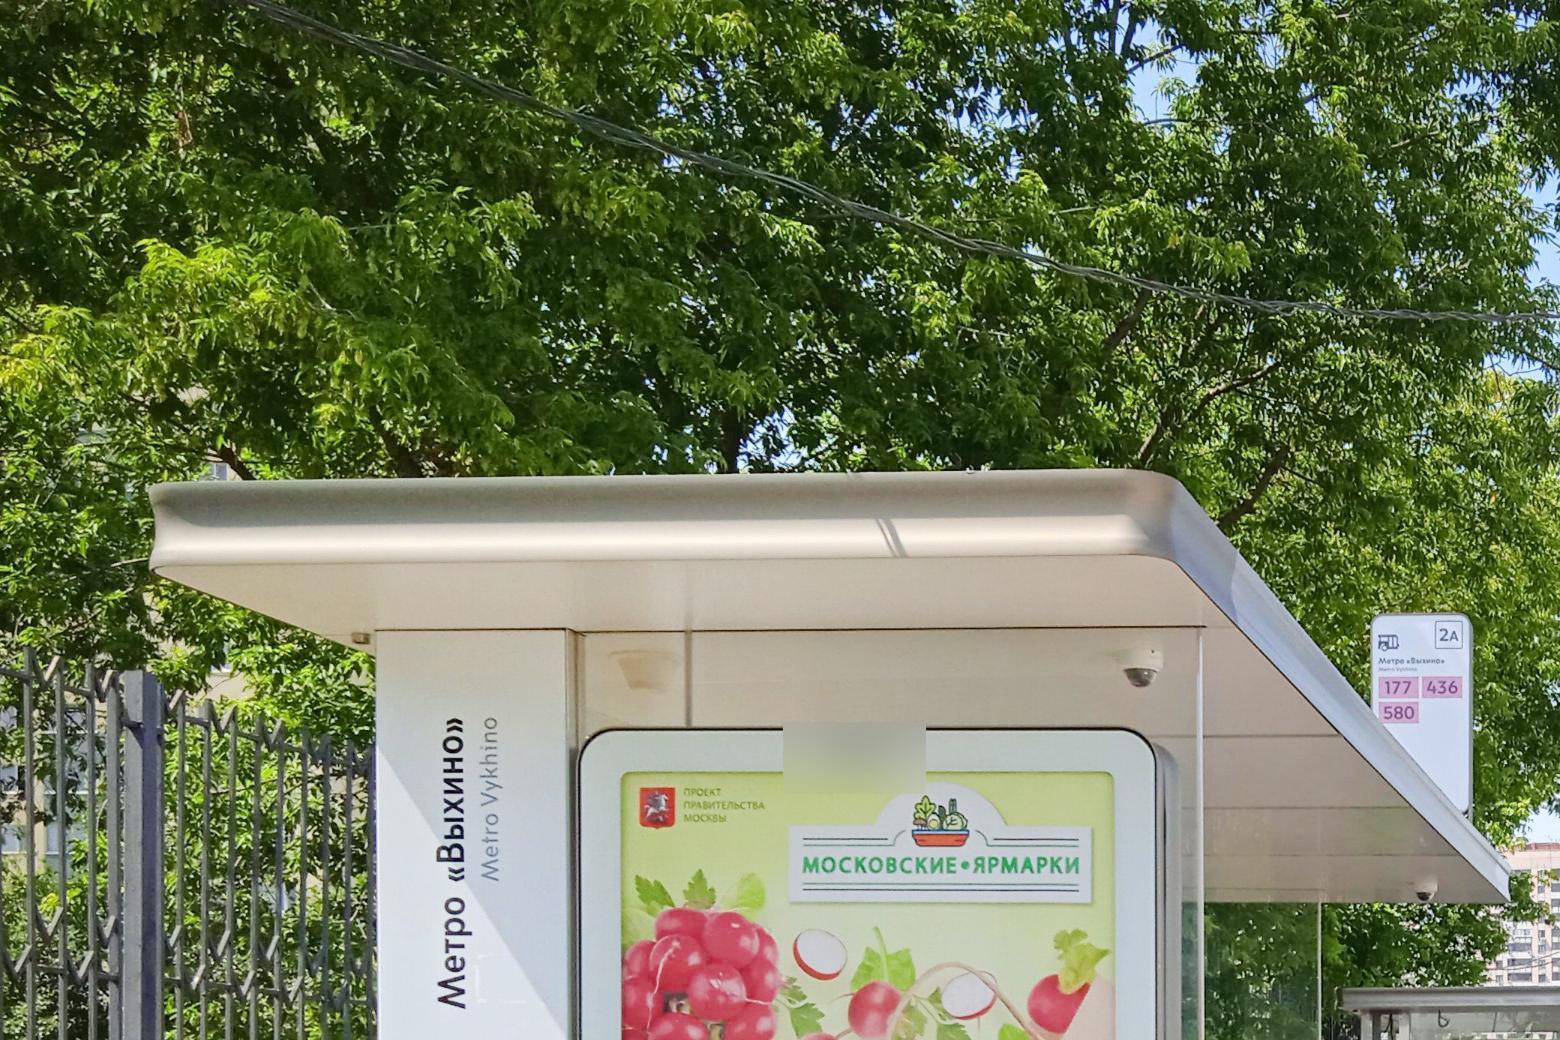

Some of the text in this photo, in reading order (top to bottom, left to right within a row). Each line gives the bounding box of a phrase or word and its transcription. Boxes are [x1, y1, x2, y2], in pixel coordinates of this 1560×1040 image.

[1385, 681, 1458, 695] 177 436
[1383, 706, 1415, 720] 580
[479, 716, 503, 882] Metro Vykhino
[683, 787, 721, 797] ПРОЕКТ
[683, 800, 766, 810] ПРАВИТЕЛЬСТВА
[683, 814, 727, 823] МОСКВЫ
[436, 717, 472, 1009] Метро «Выхино»
[802, 856, 1080, 875] МОСКОВСКИЕ ЯРМАРКИ
